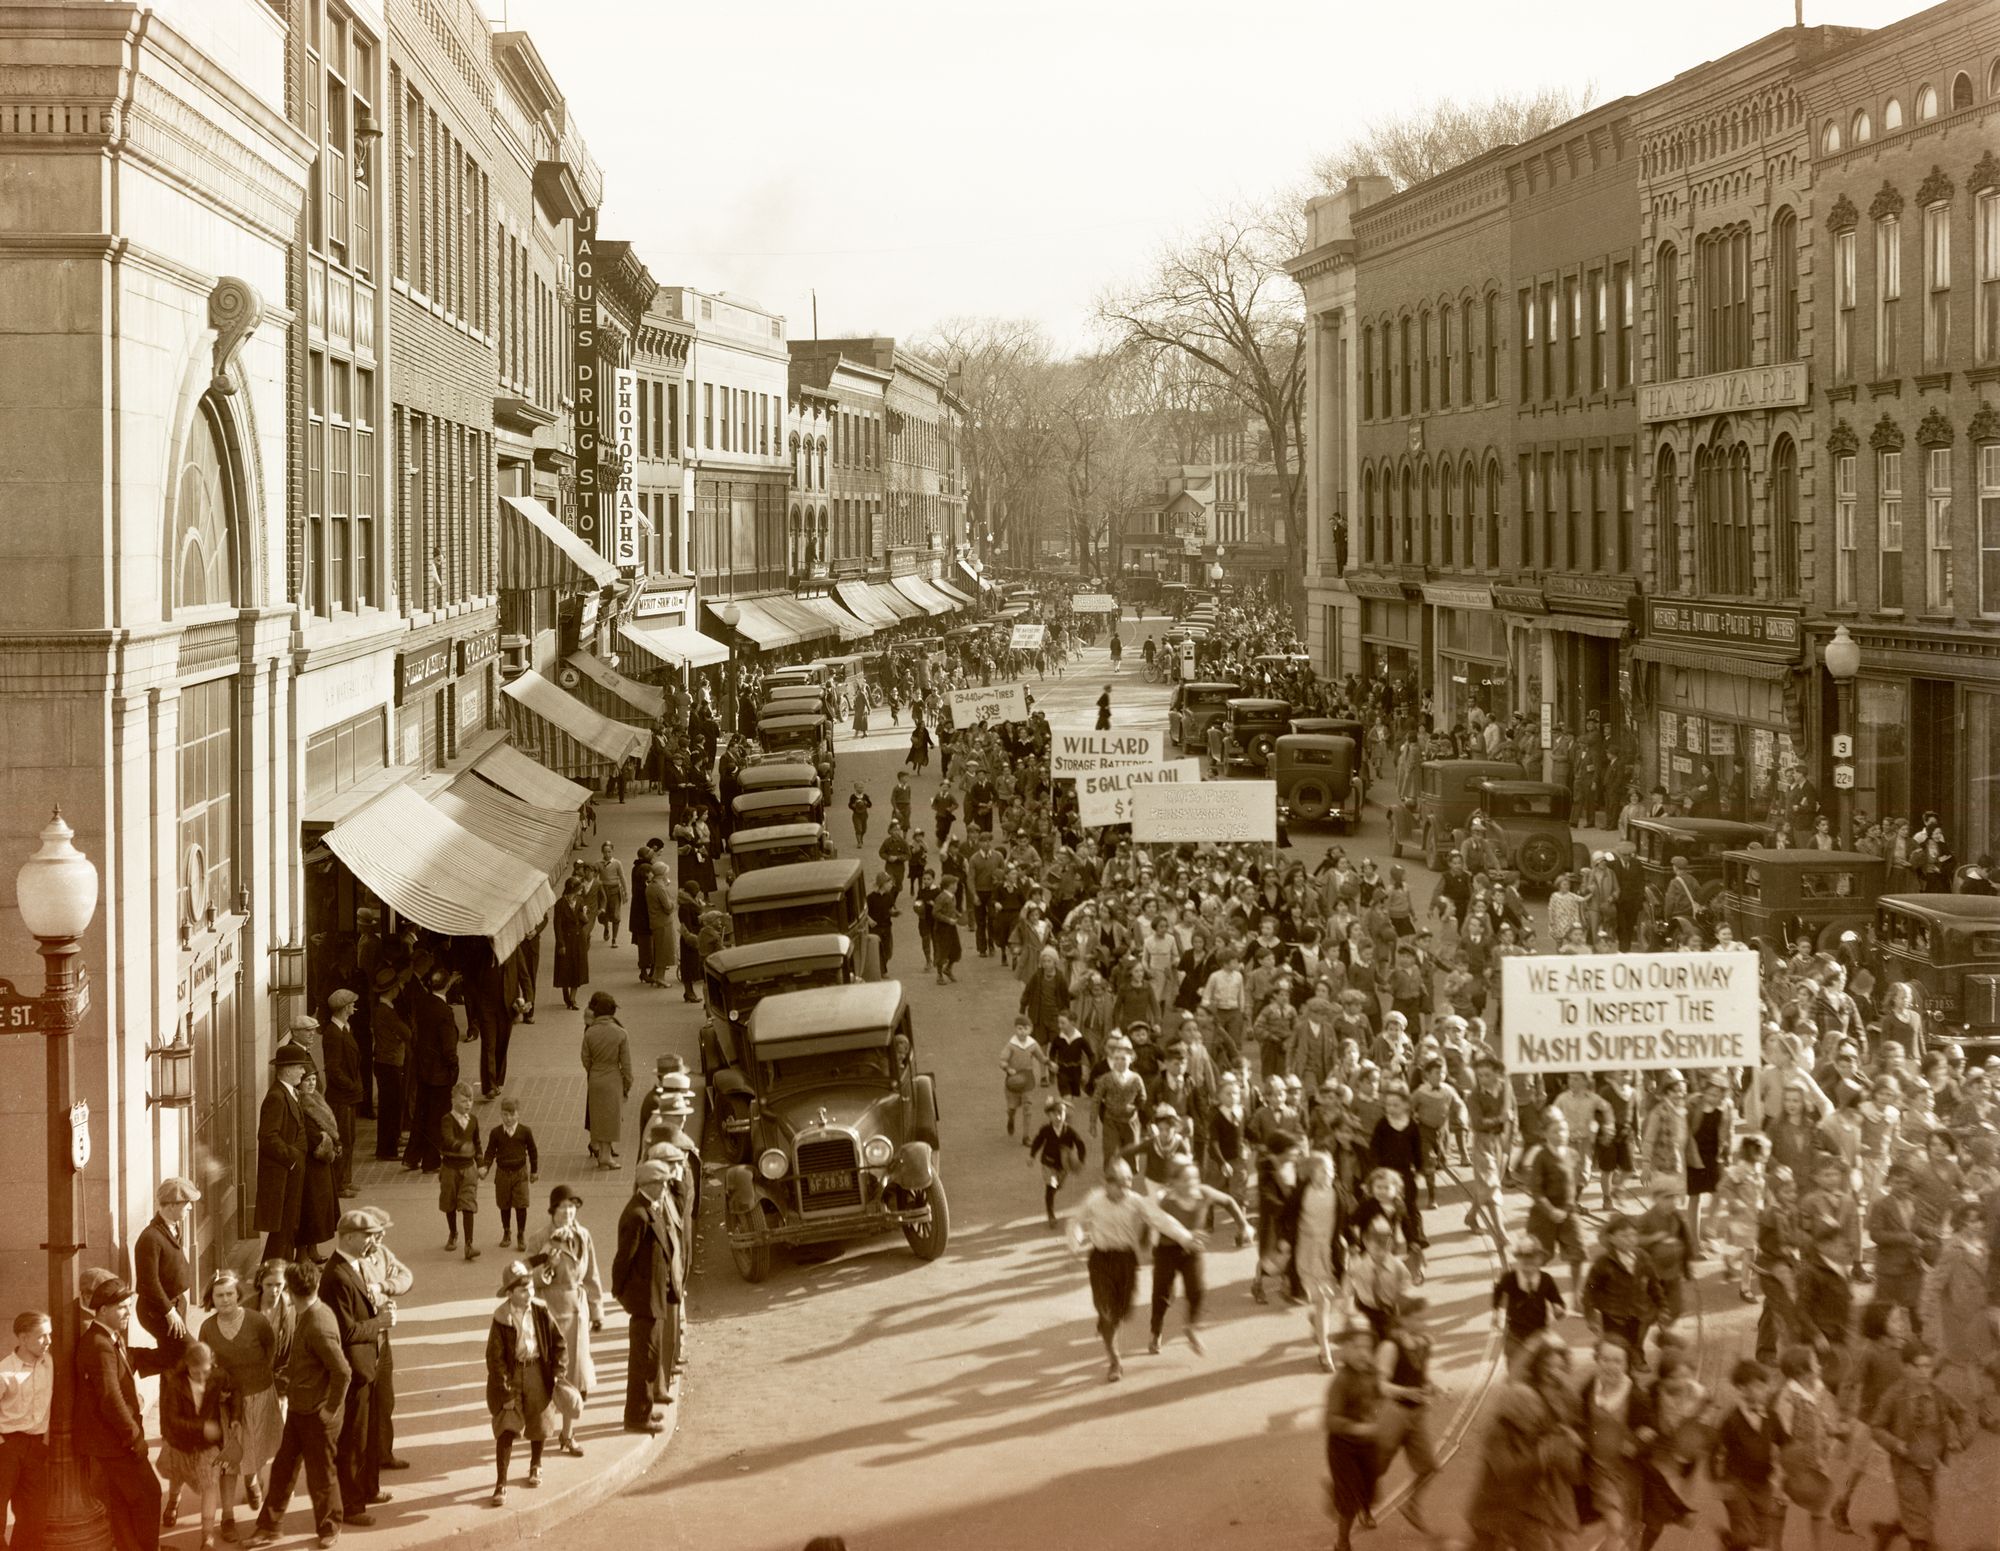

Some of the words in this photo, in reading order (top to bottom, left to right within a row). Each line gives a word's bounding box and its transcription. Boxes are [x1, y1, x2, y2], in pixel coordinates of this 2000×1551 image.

[578, 216, 592, 347] JAQUES
[1647, 370, 1796, 418] HARDWARE
[579, 366, 593, 450] DRUG
[618, 376, 634, 558] PHOTOGRAPHS
[657, 597, 671, 608] SHOE
[1654, 608, 1676, 627] MEATS
[1692, 610, 1720, 632] ATLANTIC
[1725, 613, 1751, 635] PACIFIC
[994, 689, 1014, 700] TIRES
[1063, 736, 1149, 756] WILLARD
[1839, 742, 1847, 753] 3
[1054, 756, 1096, 772] STORAGE
[1086, 777, 1097, 795] 5
[1126, 770, 1153, 791] CAN
[1526, 964, 1559, 993] WE
[1565, 962, 1606, 992] ARE
[1612, 962, 1643, 990] ON
[1649, 962, 1688, 990] OUR
[1689, 960, 1734, 990] WAY
[11, 1005, 35, 1026] ST.
[1556, 998, 1578, 1025] TO
[1585, 997, 1668, 1025] INSPECT
[1673, 993, 1715, 1022] THE
[1517, 1032, 1582, 1063] NASH
[1587, 1030, 1657, 1061] SUPER
[1660, 1028, 1743, 1059] SERVICE
